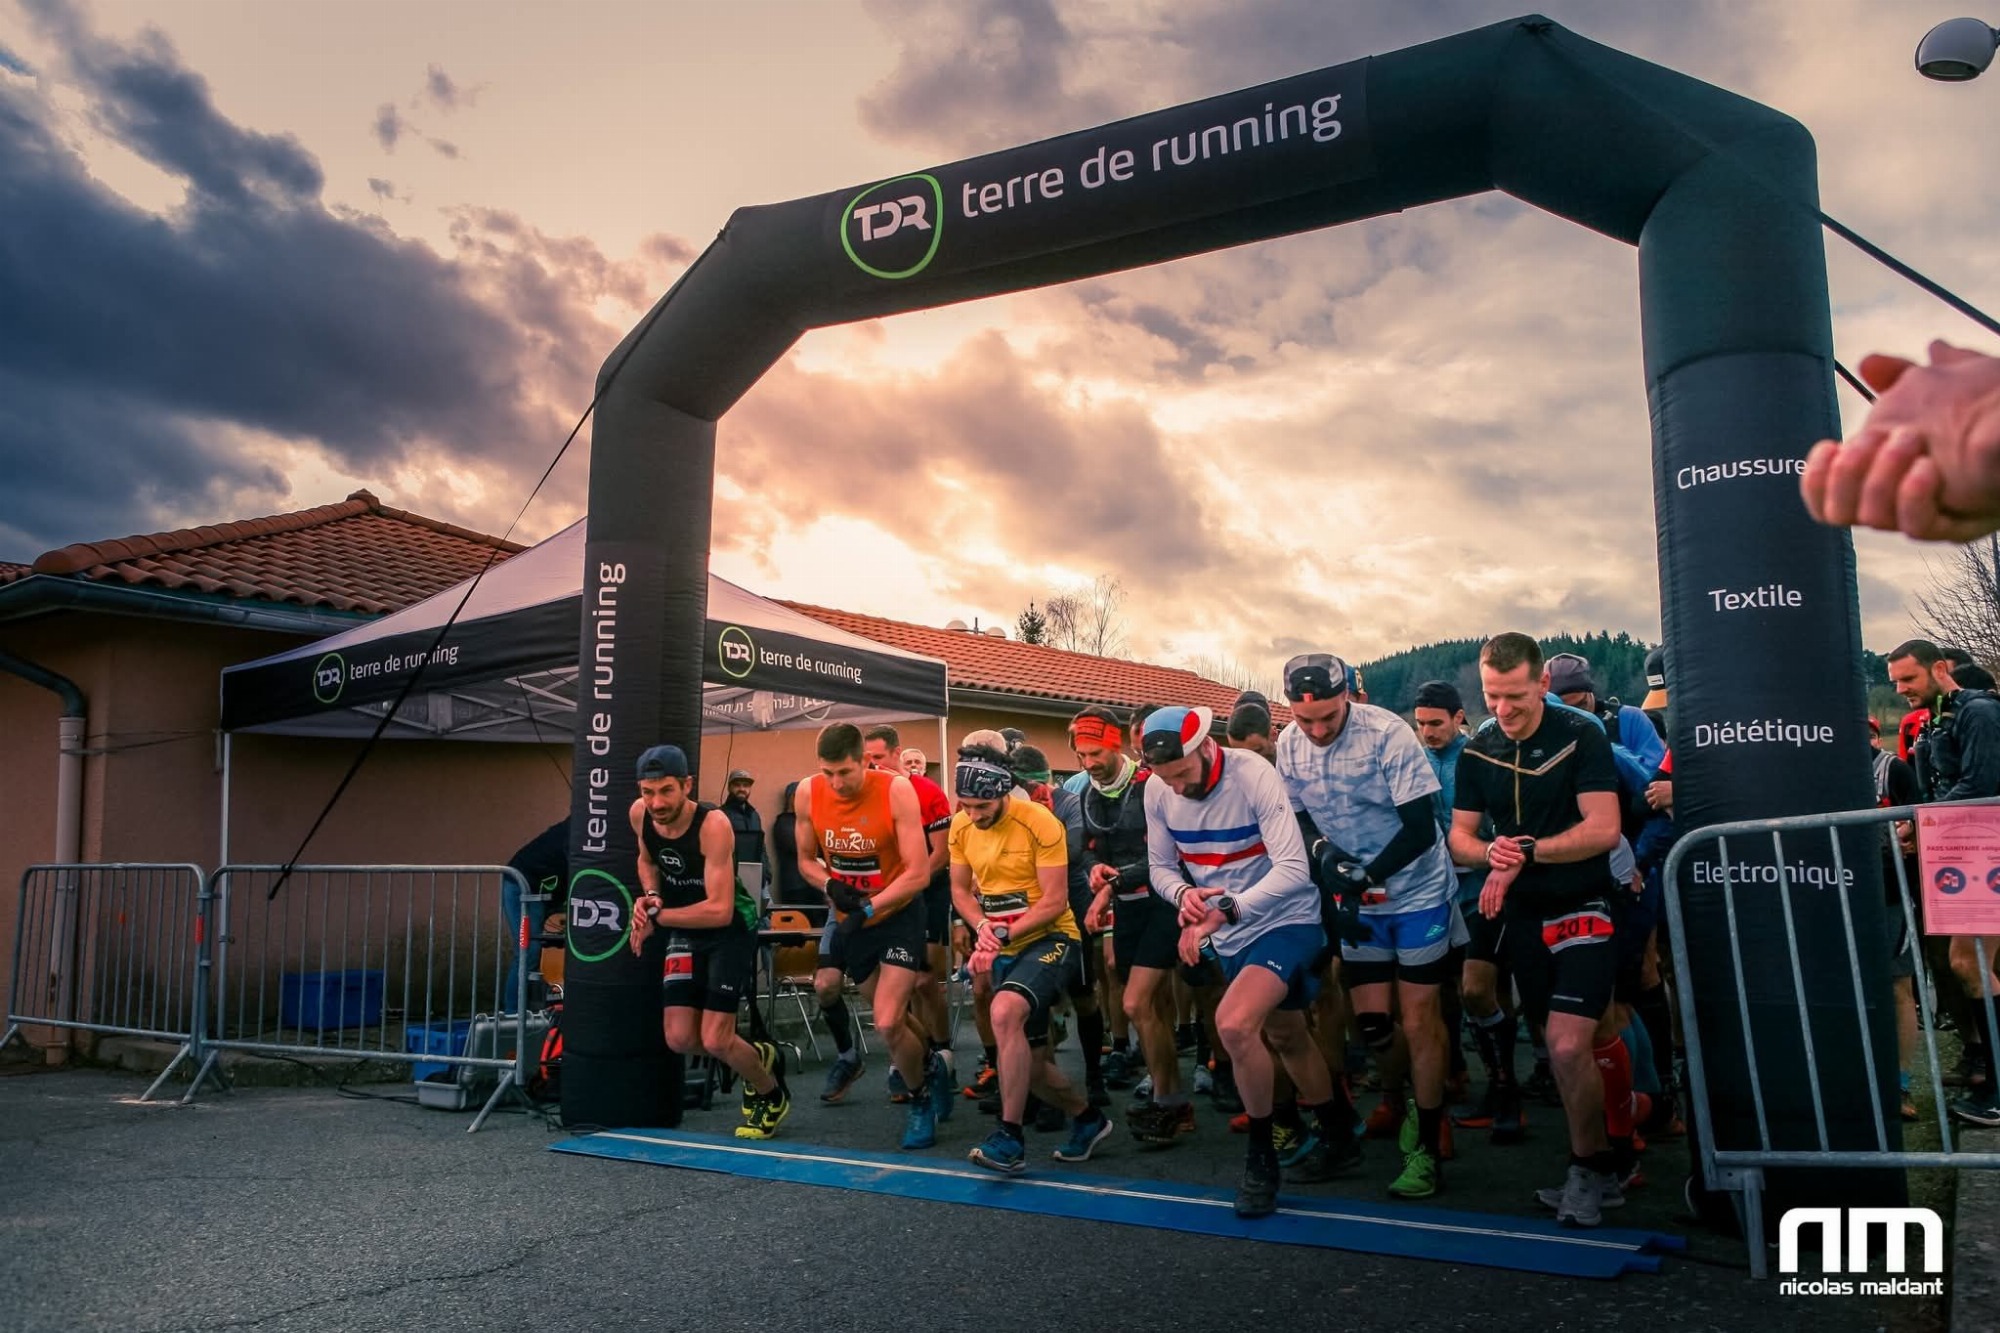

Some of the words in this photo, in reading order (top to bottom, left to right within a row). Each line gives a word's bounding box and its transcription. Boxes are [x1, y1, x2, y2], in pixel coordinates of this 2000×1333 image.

[962, 167, 1064, 218] terre
[1080, 146, 1135, 189] de
[1152, 93, 1342, 172] running
[853, 195, 931, 242] TDR
[1708, 584, 1802, 612] Textile
[592, 562, 627, 700] running
[350, 663, 381, 680] terre
[384, 654, 401, 673] de
[722, 641, 751, 662] TDR
[760, 647, 792, 668] terre
[795, 653, 812, 672] de
[815, 660, 863, 685] running
[317, 667, 341, 687] TDR
[586, 712, 612, 756] de
[1695, 718, 1834, 748] Diététique
[582, 767, 609, 853] terre
[570, 897, 623, 931] TDR
[1557, 917, 1594, 940] 201
